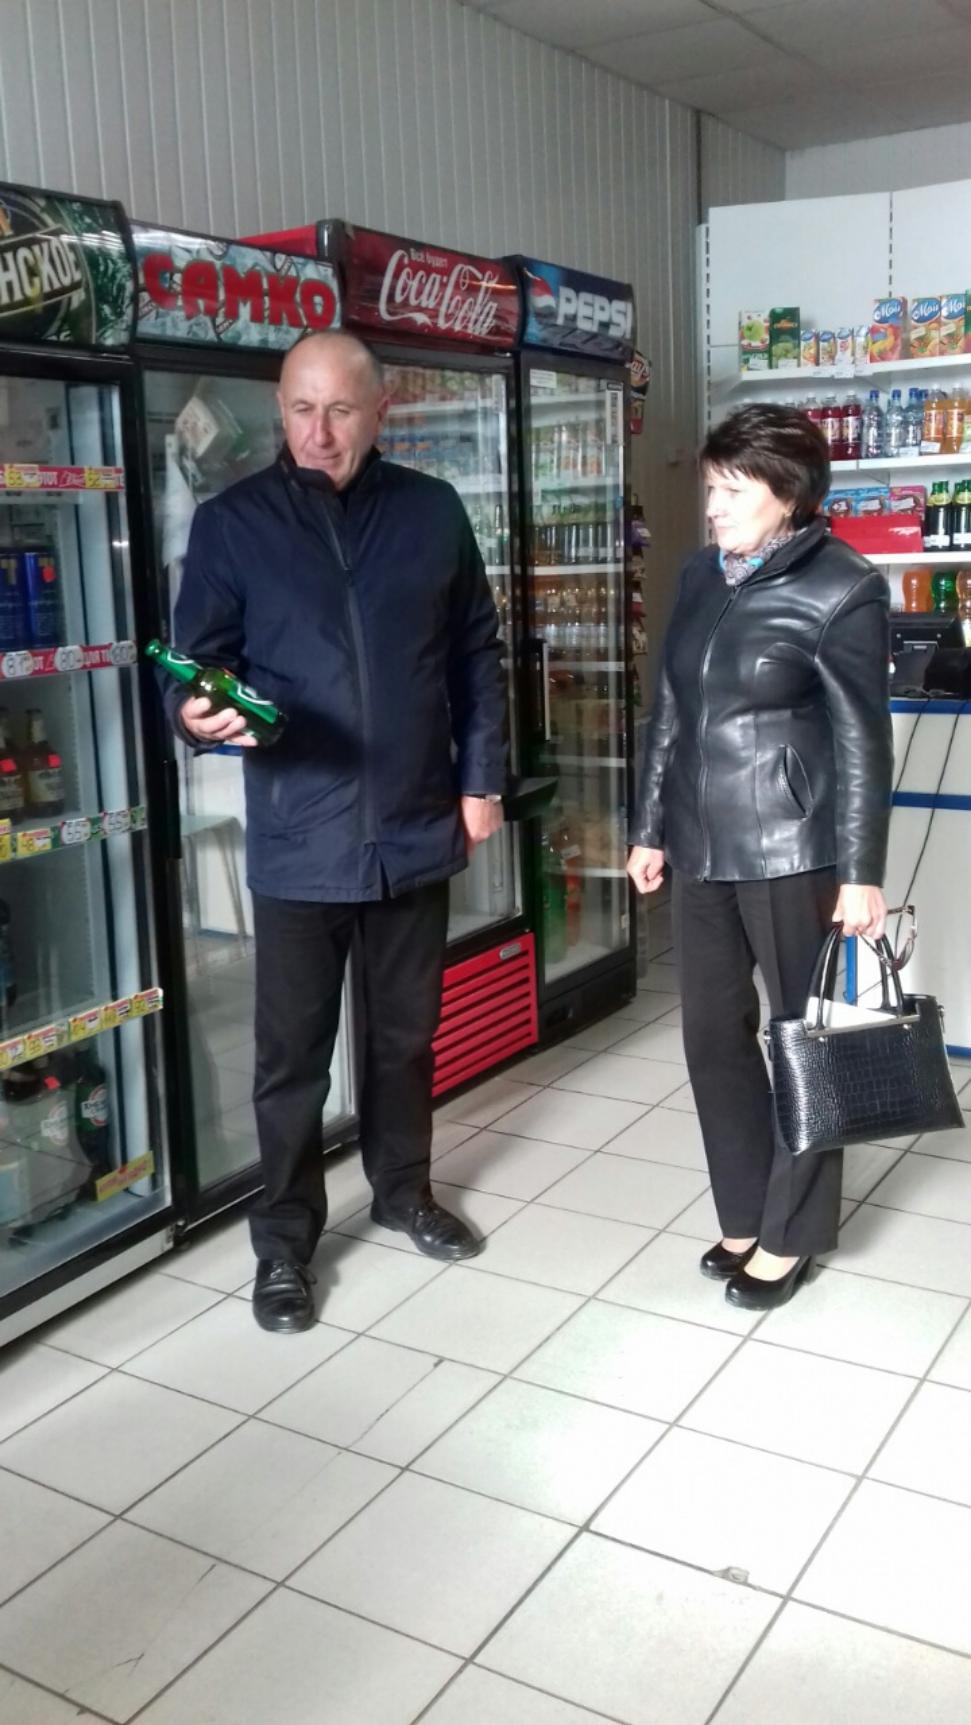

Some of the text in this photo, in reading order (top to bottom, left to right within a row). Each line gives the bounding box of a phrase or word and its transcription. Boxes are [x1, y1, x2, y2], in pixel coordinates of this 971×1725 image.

[143, 252, 336, 330] САМКО
[379, 249, 499, 336] Coca-Cola
[556, 286, 633, 339] PEPSI
